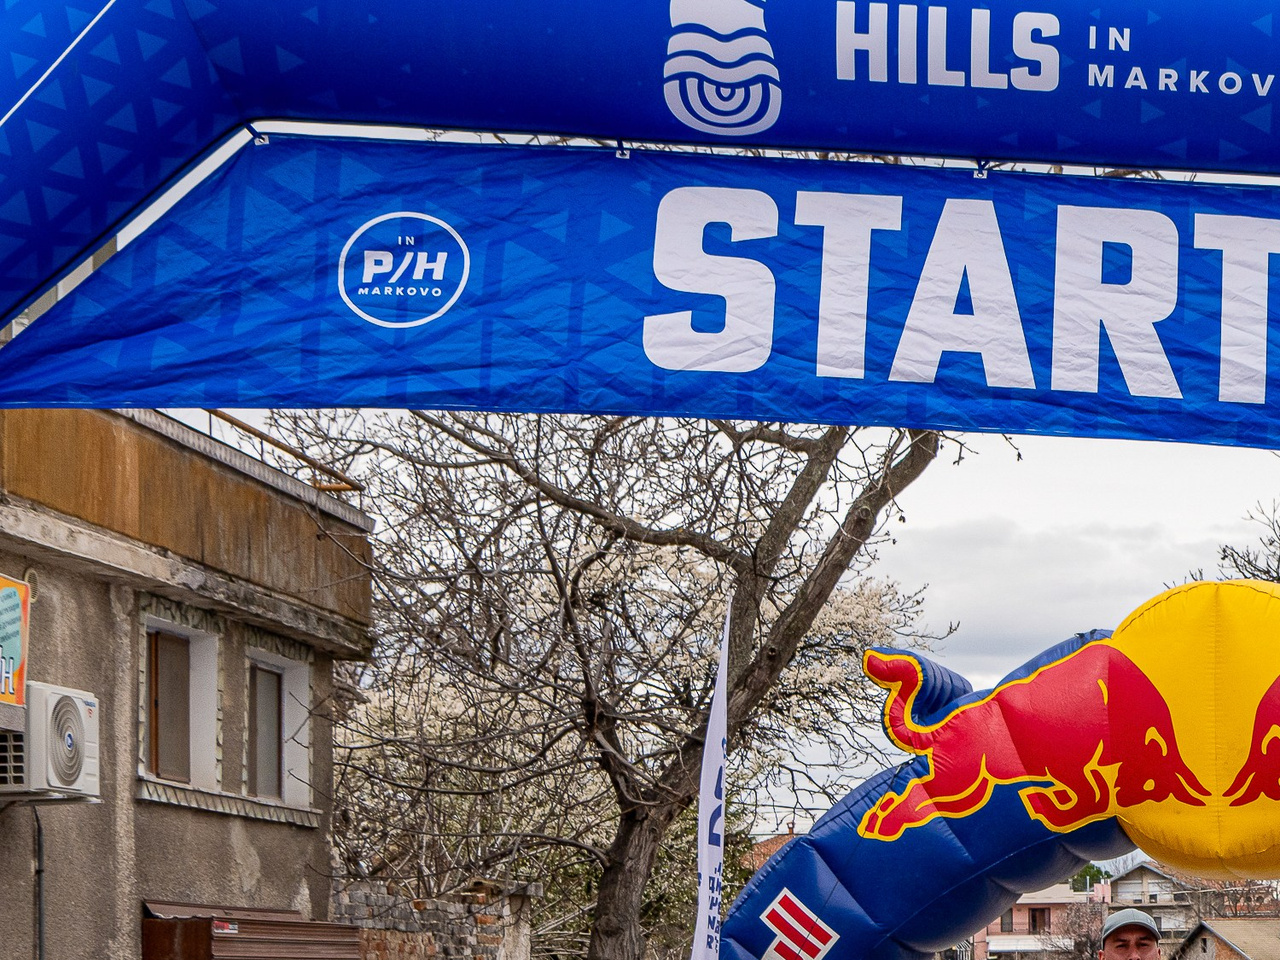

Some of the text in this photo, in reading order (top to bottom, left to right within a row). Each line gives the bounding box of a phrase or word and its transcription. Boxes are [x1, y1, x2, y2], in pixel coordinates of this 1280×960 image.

[836, 0, 1061, 92] HILLS
[1089, 26, 1131, 52] IN
[397, 236, 415, 246] IN
[362, 250, 448, 284] P/H
[358, 286, 442, 297] MARKOVO
